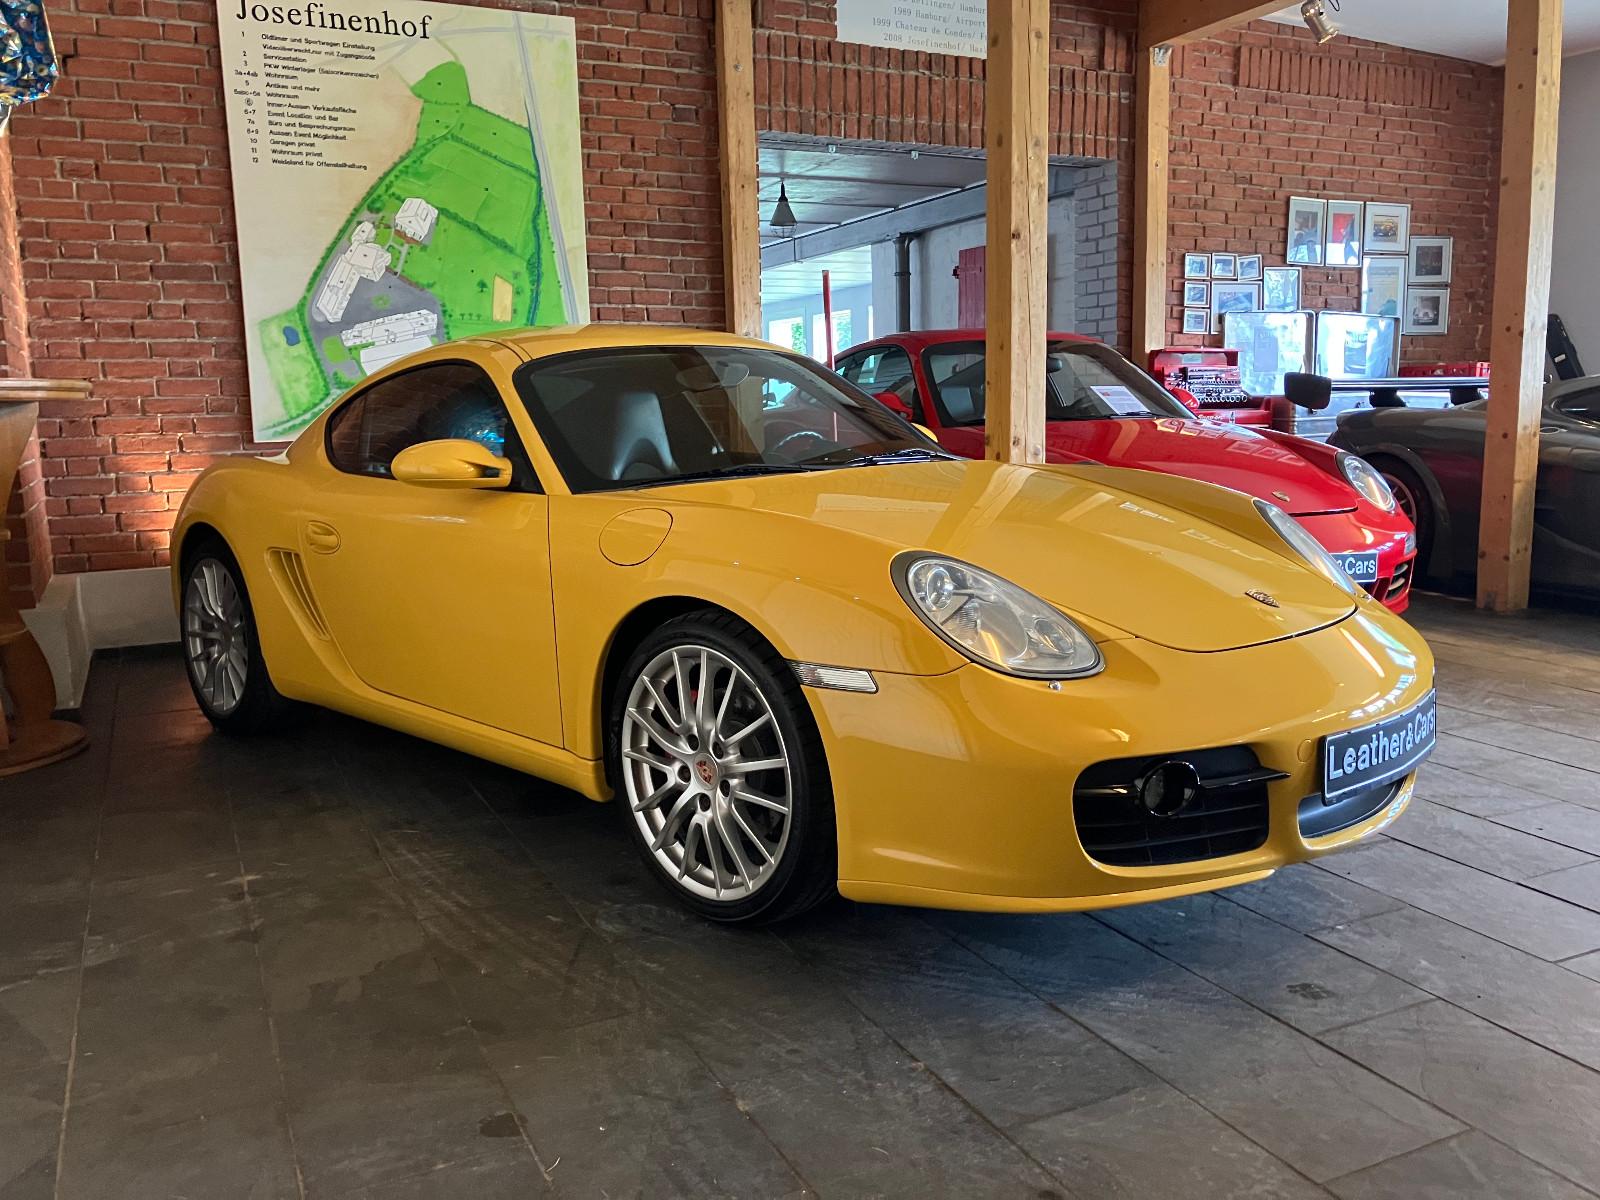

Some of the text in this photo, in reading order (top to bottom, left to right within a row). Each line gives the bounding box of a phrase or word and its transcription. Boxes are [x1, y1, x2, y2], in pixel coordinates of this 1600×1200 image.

[893, 6, 911, 16] 1989
[960, 3, 986, 14] Hambur
[236, 0, 432, 39] Josefinenhof
[873, 17, 891, 27] 1999
[931, 26, 940, 34] de
[261, 33, 288, 41] Oldtimer
[304, 38, 340, 47] Sportwagen
[883, 33, 902, 43] 2008
